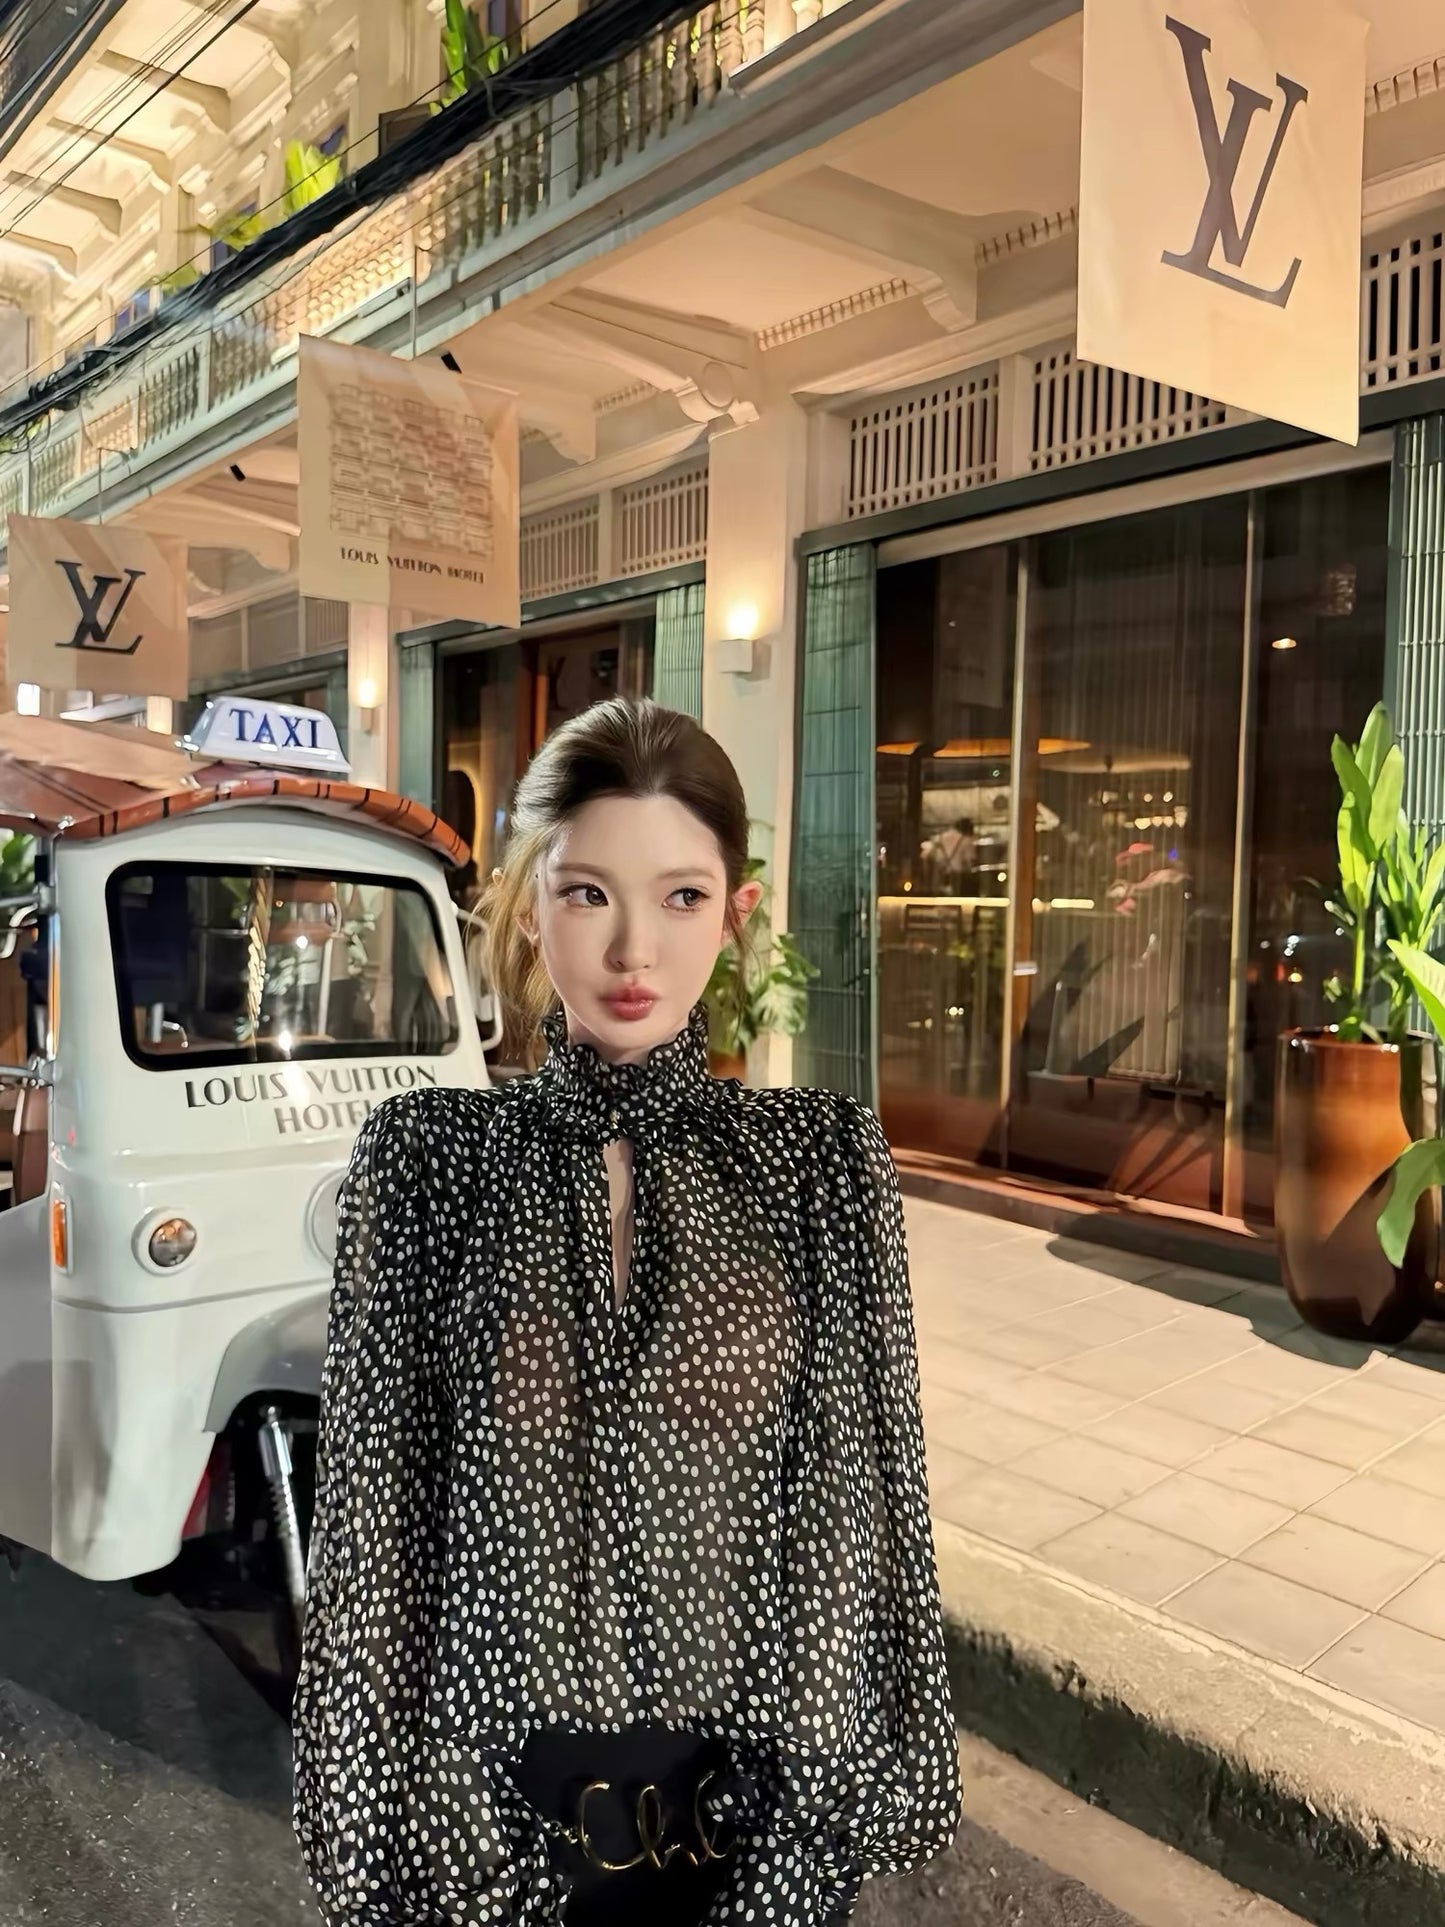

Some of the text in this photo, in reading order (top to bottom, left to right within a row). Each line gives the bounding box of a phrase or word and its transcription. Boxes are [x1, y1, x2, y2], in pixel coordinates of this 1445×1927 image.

[228, 708, 321, 748] TAXI
[184, 1064, 437, 1108] LOUIS VUITTON
